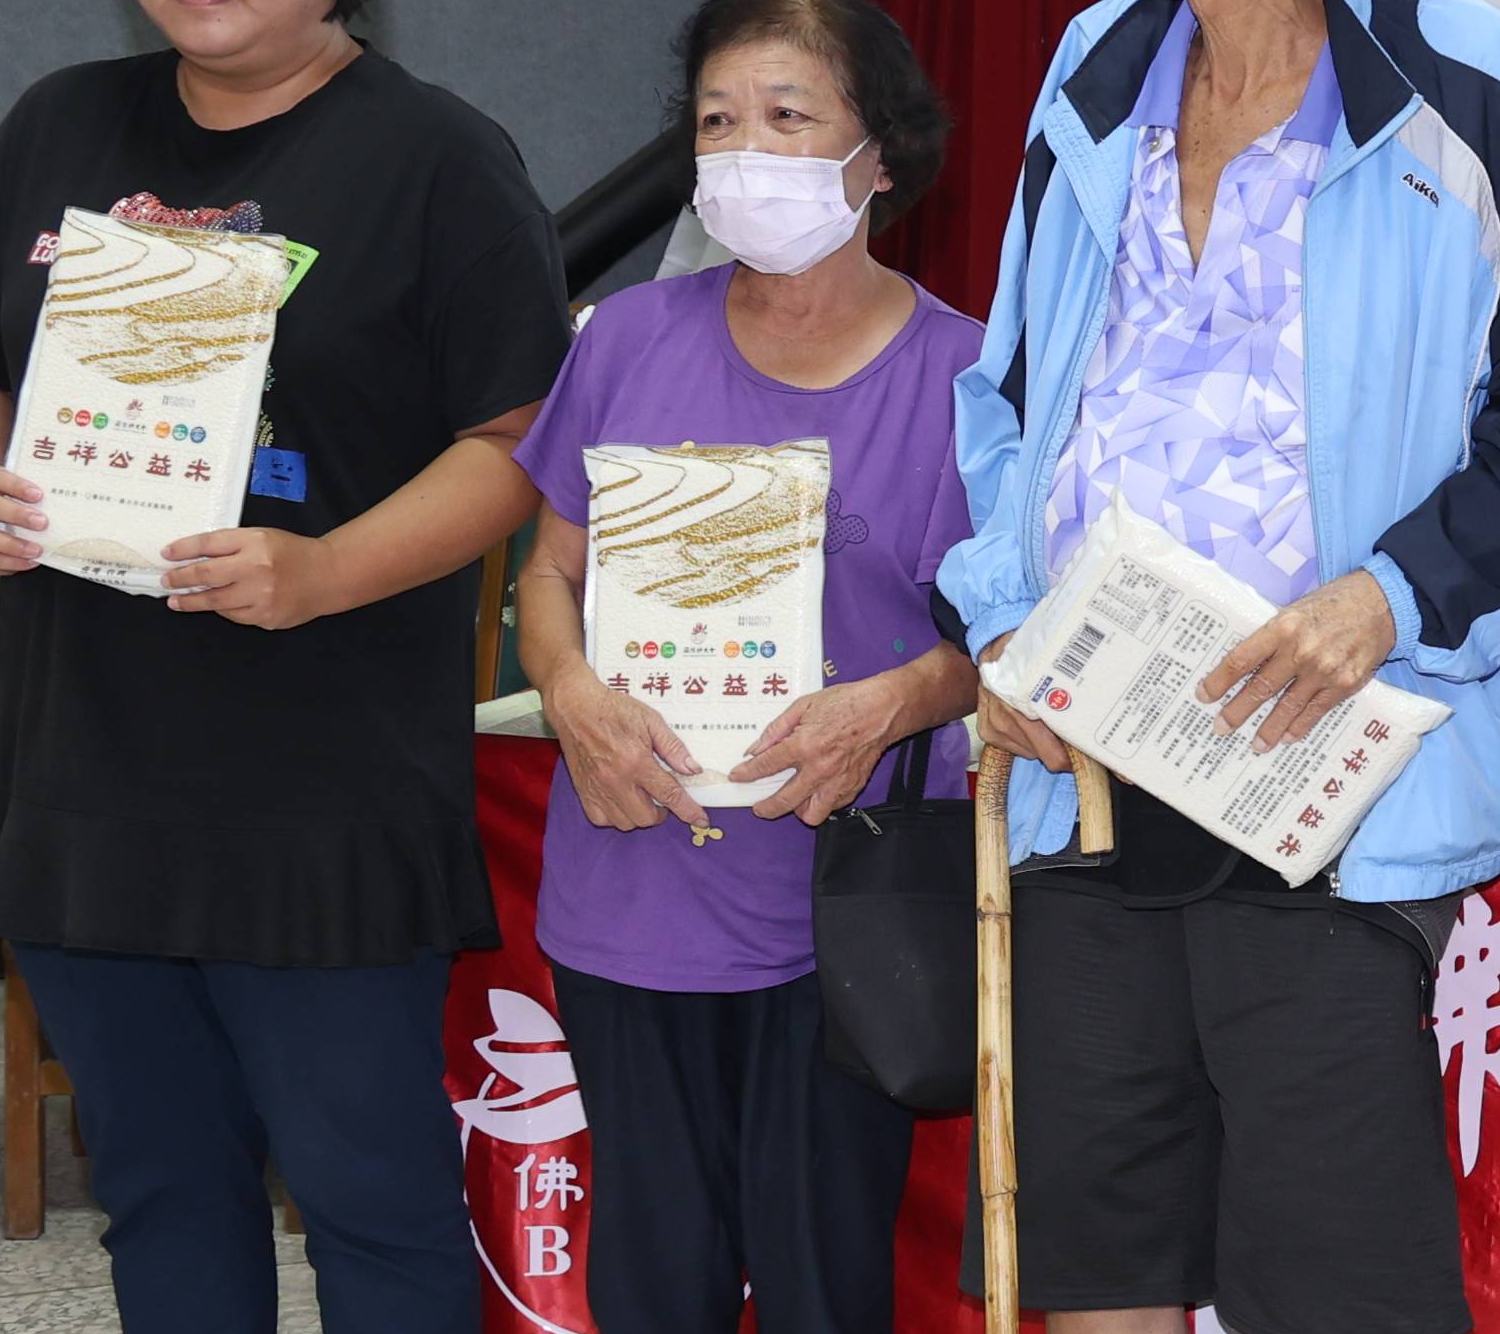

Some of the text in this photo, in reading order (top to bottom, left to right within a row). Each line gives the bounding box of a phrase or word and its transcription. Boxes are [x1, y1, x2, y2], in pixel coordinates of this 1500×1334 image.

[30, 247, 55, 262] LU
[36, 233, 60, 249] GO
[31, 436, 213, 484] 吉祥公益米
[606, 671, 790, 698] 吉祥公益米
[1275, 717, 1390, 857] 吉祥公益米
